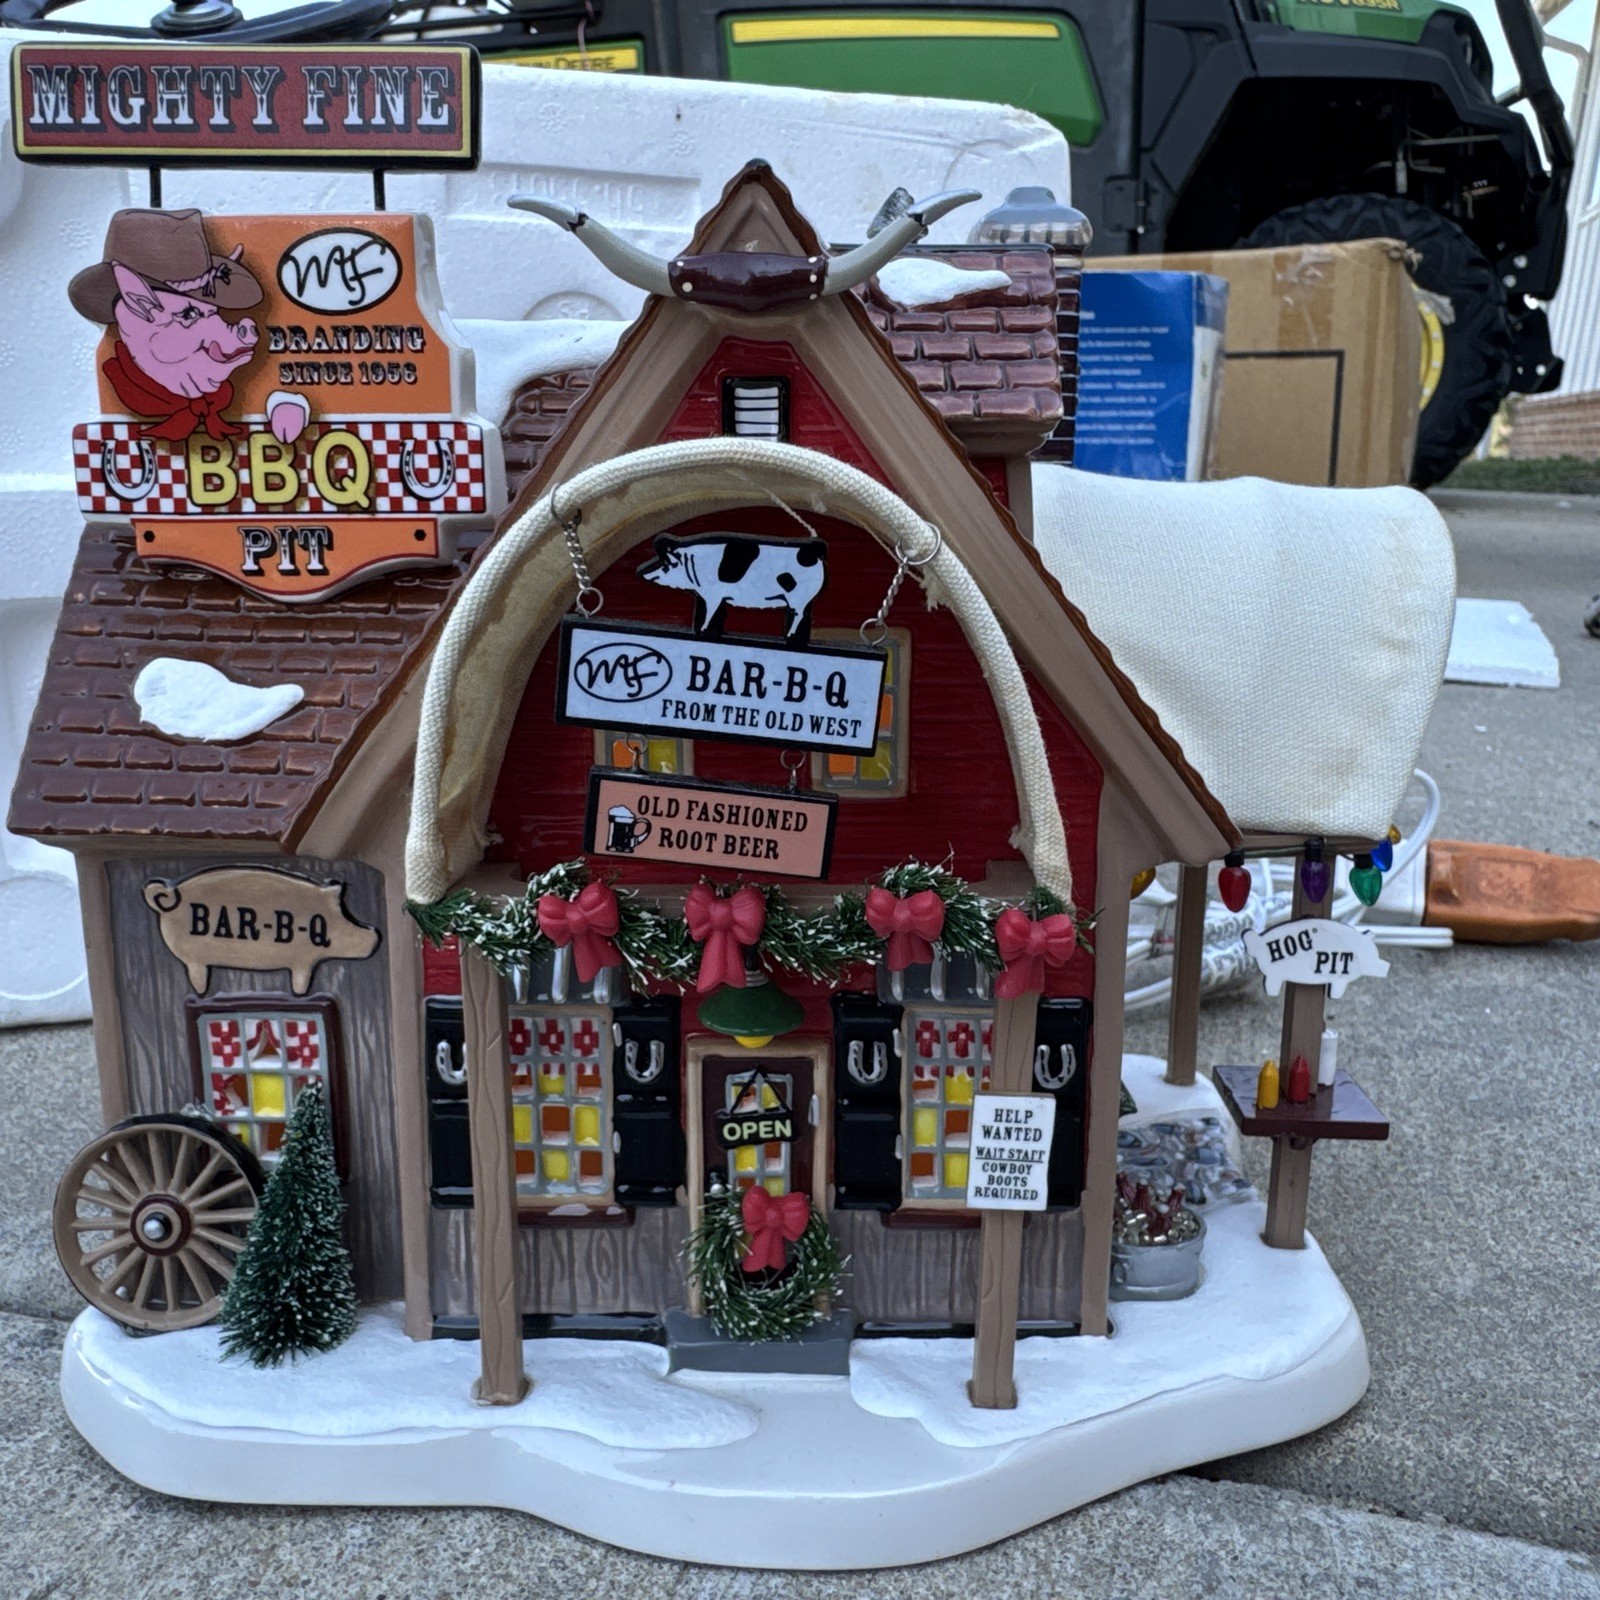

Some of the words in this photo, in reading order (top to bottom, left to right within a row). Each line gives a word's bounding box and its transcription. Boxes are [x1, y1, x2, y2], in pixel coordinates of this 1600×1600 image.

[26, 64, 285, 133] MIGHTY
[301, 66, 455, 134] FINE
[266, 325, 426, 353] BRANDING
[279, 361, 354, 386] SINCE
[186, 429, 373, 511] BBQ
[238, 525, 334, 576] PIT
[686, 655, 849, 708] BAR-B-Q
[660, 699, 717, 722] FROM
[721, 706, 760, 728] THE
[765, 710, 802, 732] OLD
[809, 715, 862, 738] WEST
[637, 795, 681, 819] OLD
[686, 800, 808, 833] FASHIONED
[658, 827, 718, 853] ROOT
[724, 834, 780, 860] BEER
[189, 902, 331, 948] BAR-B-Q
[1314, 950, 1354, 975] PIT
[993, 1108, 1034, 1125] HELP
[722, 1119, 793, 1141] OPEN
[981, 1125, 1043, 1143] WANTED
[975, 1146, 1006, 1160] WAIT
[1007, 1148, 1046, 1162] STAFF
[981, 1162, 1033, 1176] COWBOY
[987, 1174, 1028, 1188] BOOTS
[973, 1186, 1039, 1201] REQUIRED
